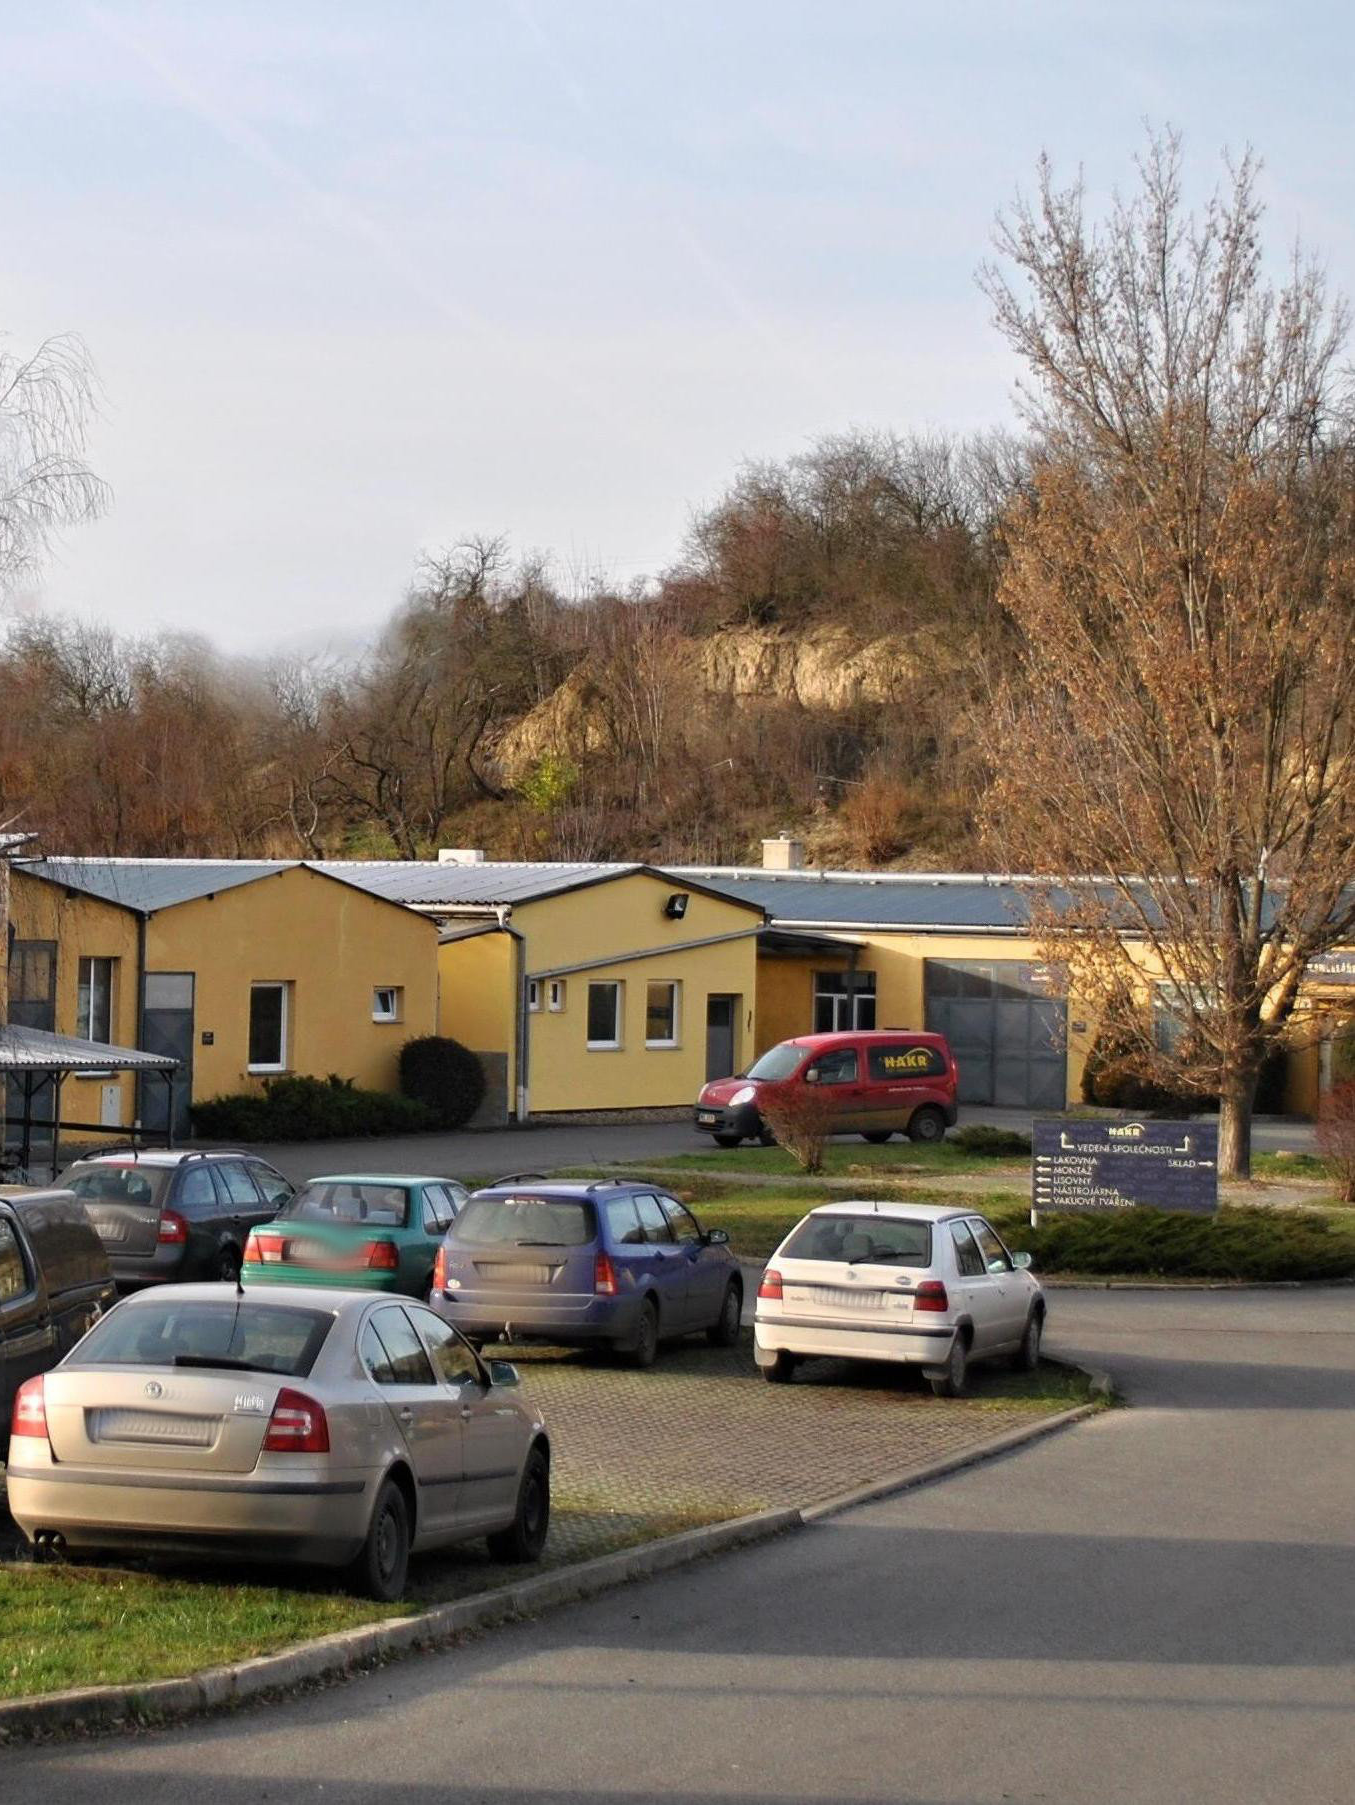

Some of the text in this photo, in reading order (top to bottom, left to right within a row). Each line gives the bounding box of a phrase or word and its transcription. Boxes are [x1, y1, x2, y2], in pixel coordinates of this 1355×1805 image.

[884, 1055, 927, 1068] HAKR
[1108, 1127, 1140, 1137] HAKR
[1077, 1142, 1173, 1155] VEDENÍ SPOLEČNOSTI
[1053, 1156, 1098, 1166] LAKOVNA
[1167, 1159, 1196, 1168] SKLAD
[1053, 1176, 1092, 1186] LISOVNY
